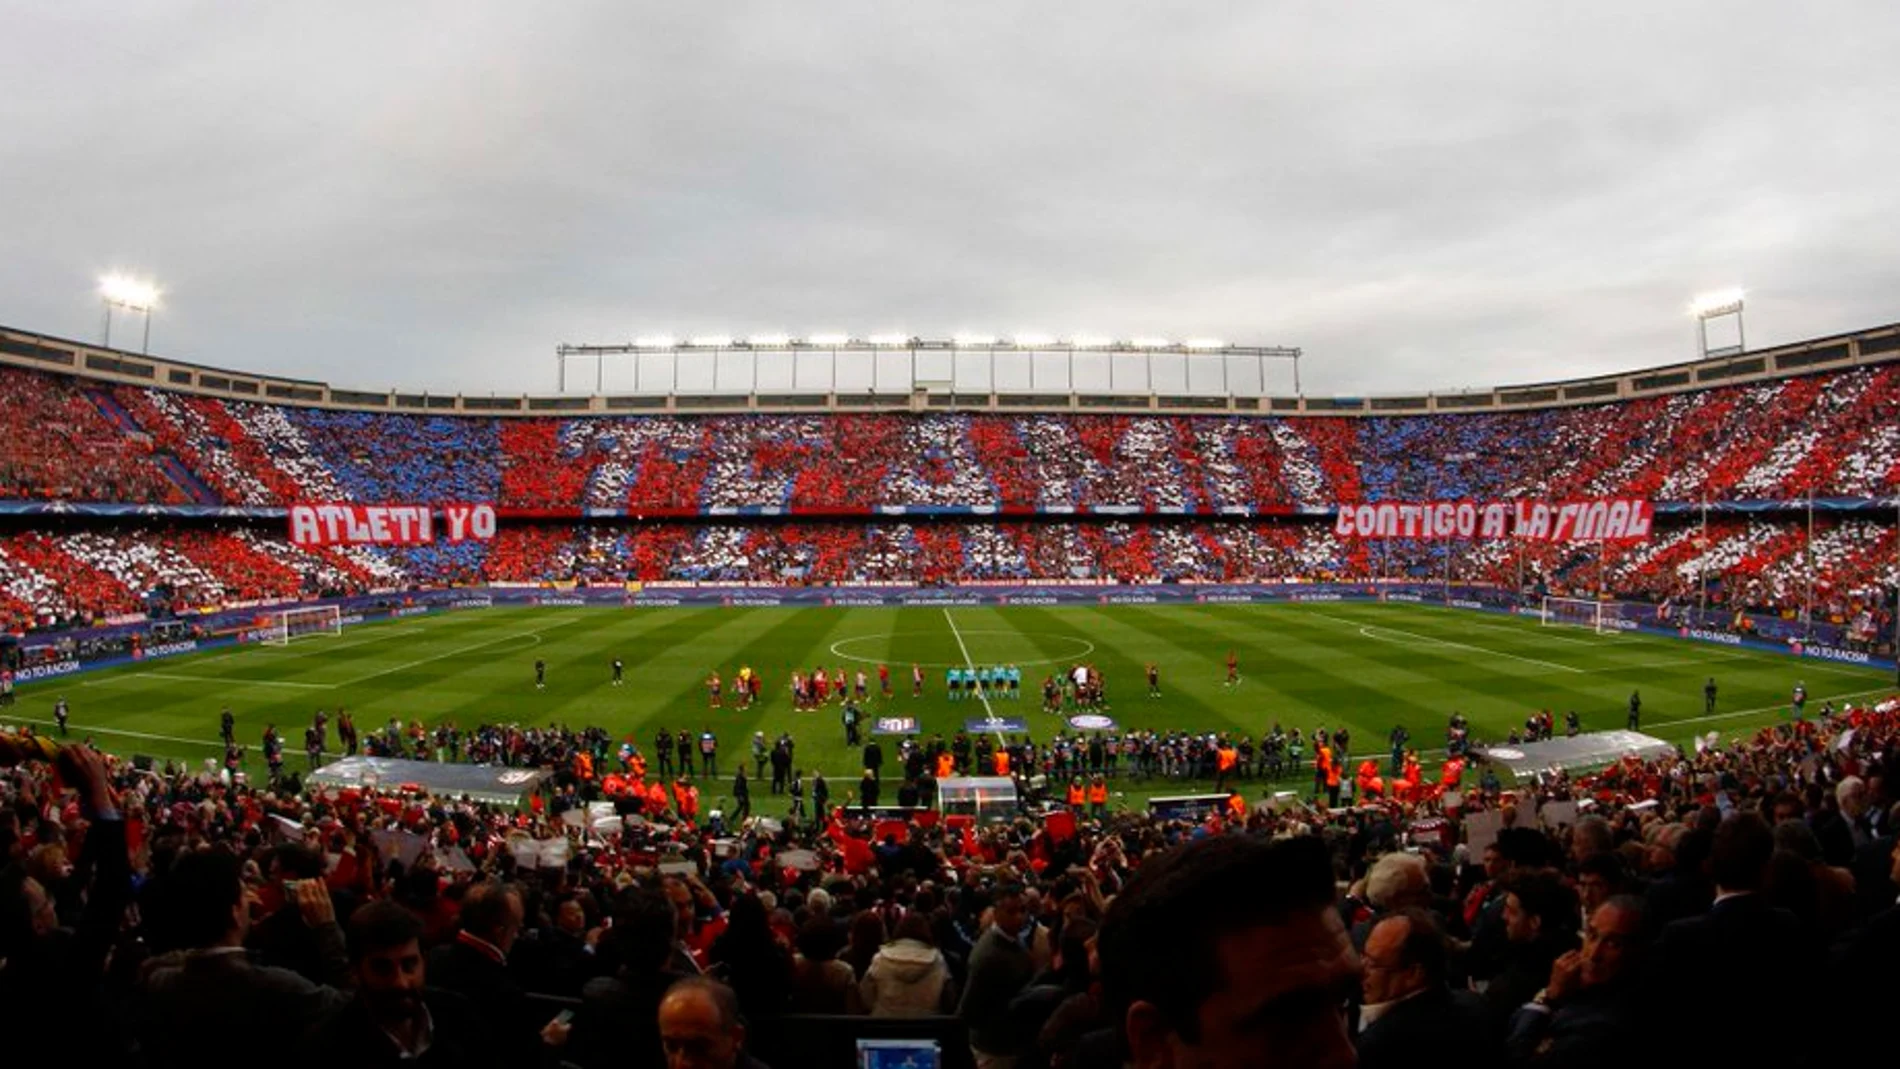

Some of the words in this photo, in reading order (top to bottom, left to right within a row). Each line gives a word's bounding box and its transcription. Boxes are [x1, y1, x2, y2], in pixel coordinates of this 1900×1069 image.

[292, 505, 431, 544] ATLETI
[449, 505, 496, 539] YO
[1336, 502, 1476, 537] CONTIGO
[1482, 504, 1506, 536] A
[1515, 503, 1549, 536] LA
[1552, 501, 1651, 539] FINAL
[1713, 631, 1741, 645] RACISM
[1805, 645, 1820, 656] NO
[1821, 646, 1833, 658] TO
[1834, 648, 1869, 662] RACISM
[15, 668, 31, 680] NO
[32, 665, 46, 677] TO
[46, 660, 80, 675] RACISM
